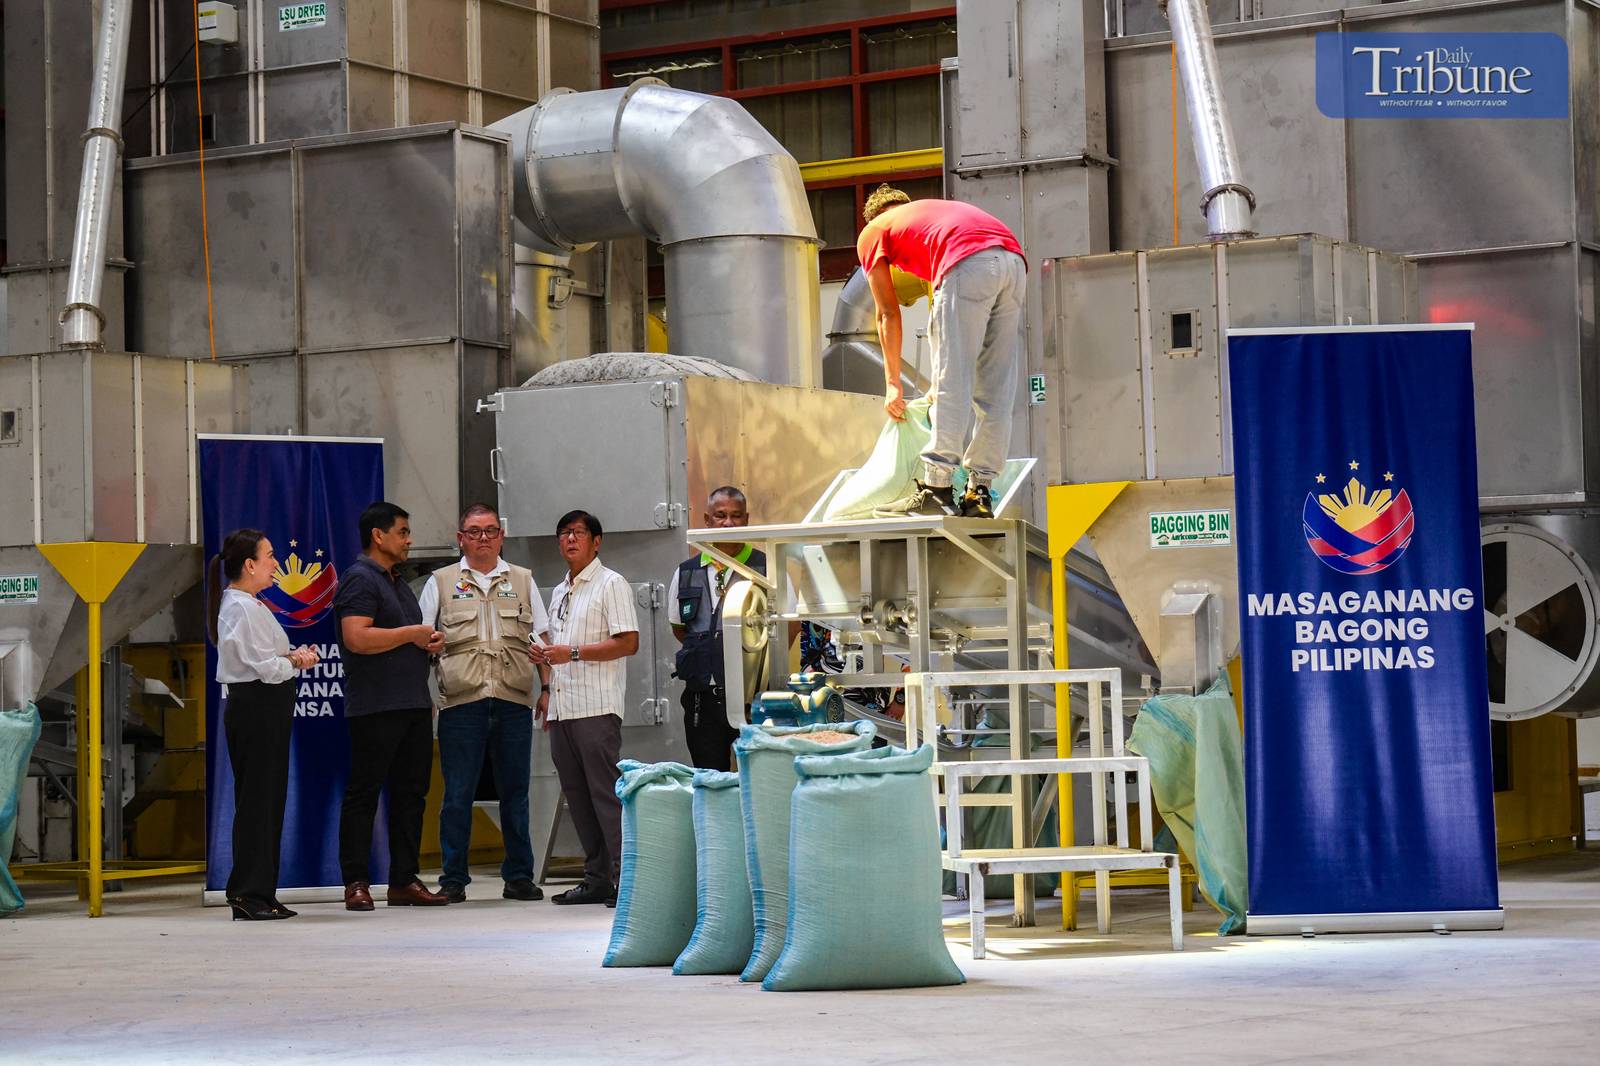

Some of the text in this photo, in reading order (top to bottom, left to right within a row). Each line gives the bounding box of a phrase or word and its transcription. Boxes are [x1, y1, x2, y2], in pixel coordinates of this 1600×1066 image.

[280, 4, 325, 21] LSU DRYER
[1151, 513, 1229, 534] BAGGING BIN
[0, 577, 38, 593] GING BIN
[1247, 588, 1475, 616] MASAGANANG
[1295, 617, 1429, 644] BAGONG
[1291, 645, 1435, 672] PILIPINAS
